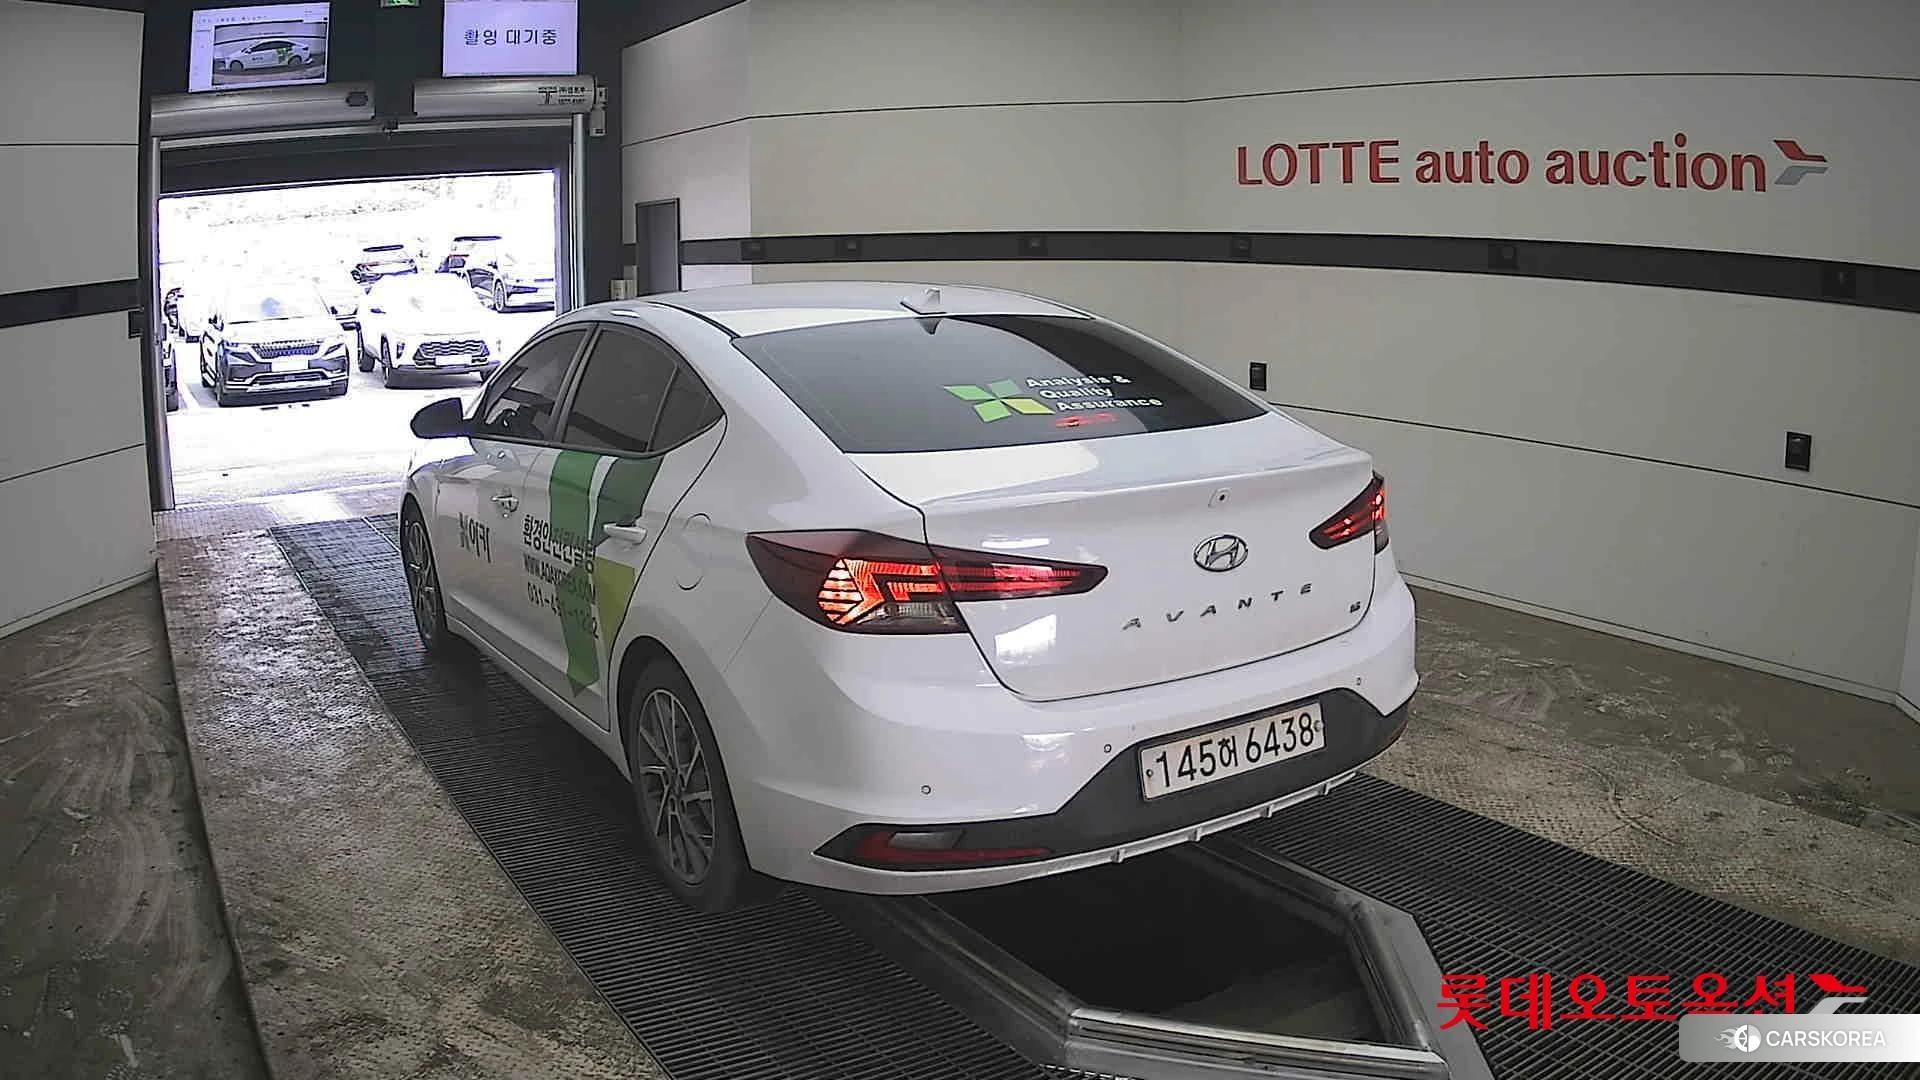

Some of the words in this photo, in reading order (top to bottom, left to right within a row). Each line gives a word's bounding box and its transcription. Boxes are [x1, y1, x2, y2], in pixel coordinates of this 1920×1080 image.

[504, 28, 558, 47] 대기중
[1237, 139, 1400, 187] LOTTE
[1415, 140, 1530, 185] auto
[1544, 132, 1767, 193] auction
[1025, 375, 1111, 388] Analysis
[1112, 374, 1132, 385] &
[1038, 387, 1114, 400] Quality
[1056, 398, 1163, 413] Assurance
[1122, 583, 1313, 631] AVANTE
[1245, 712, 1315, 764] 6438
